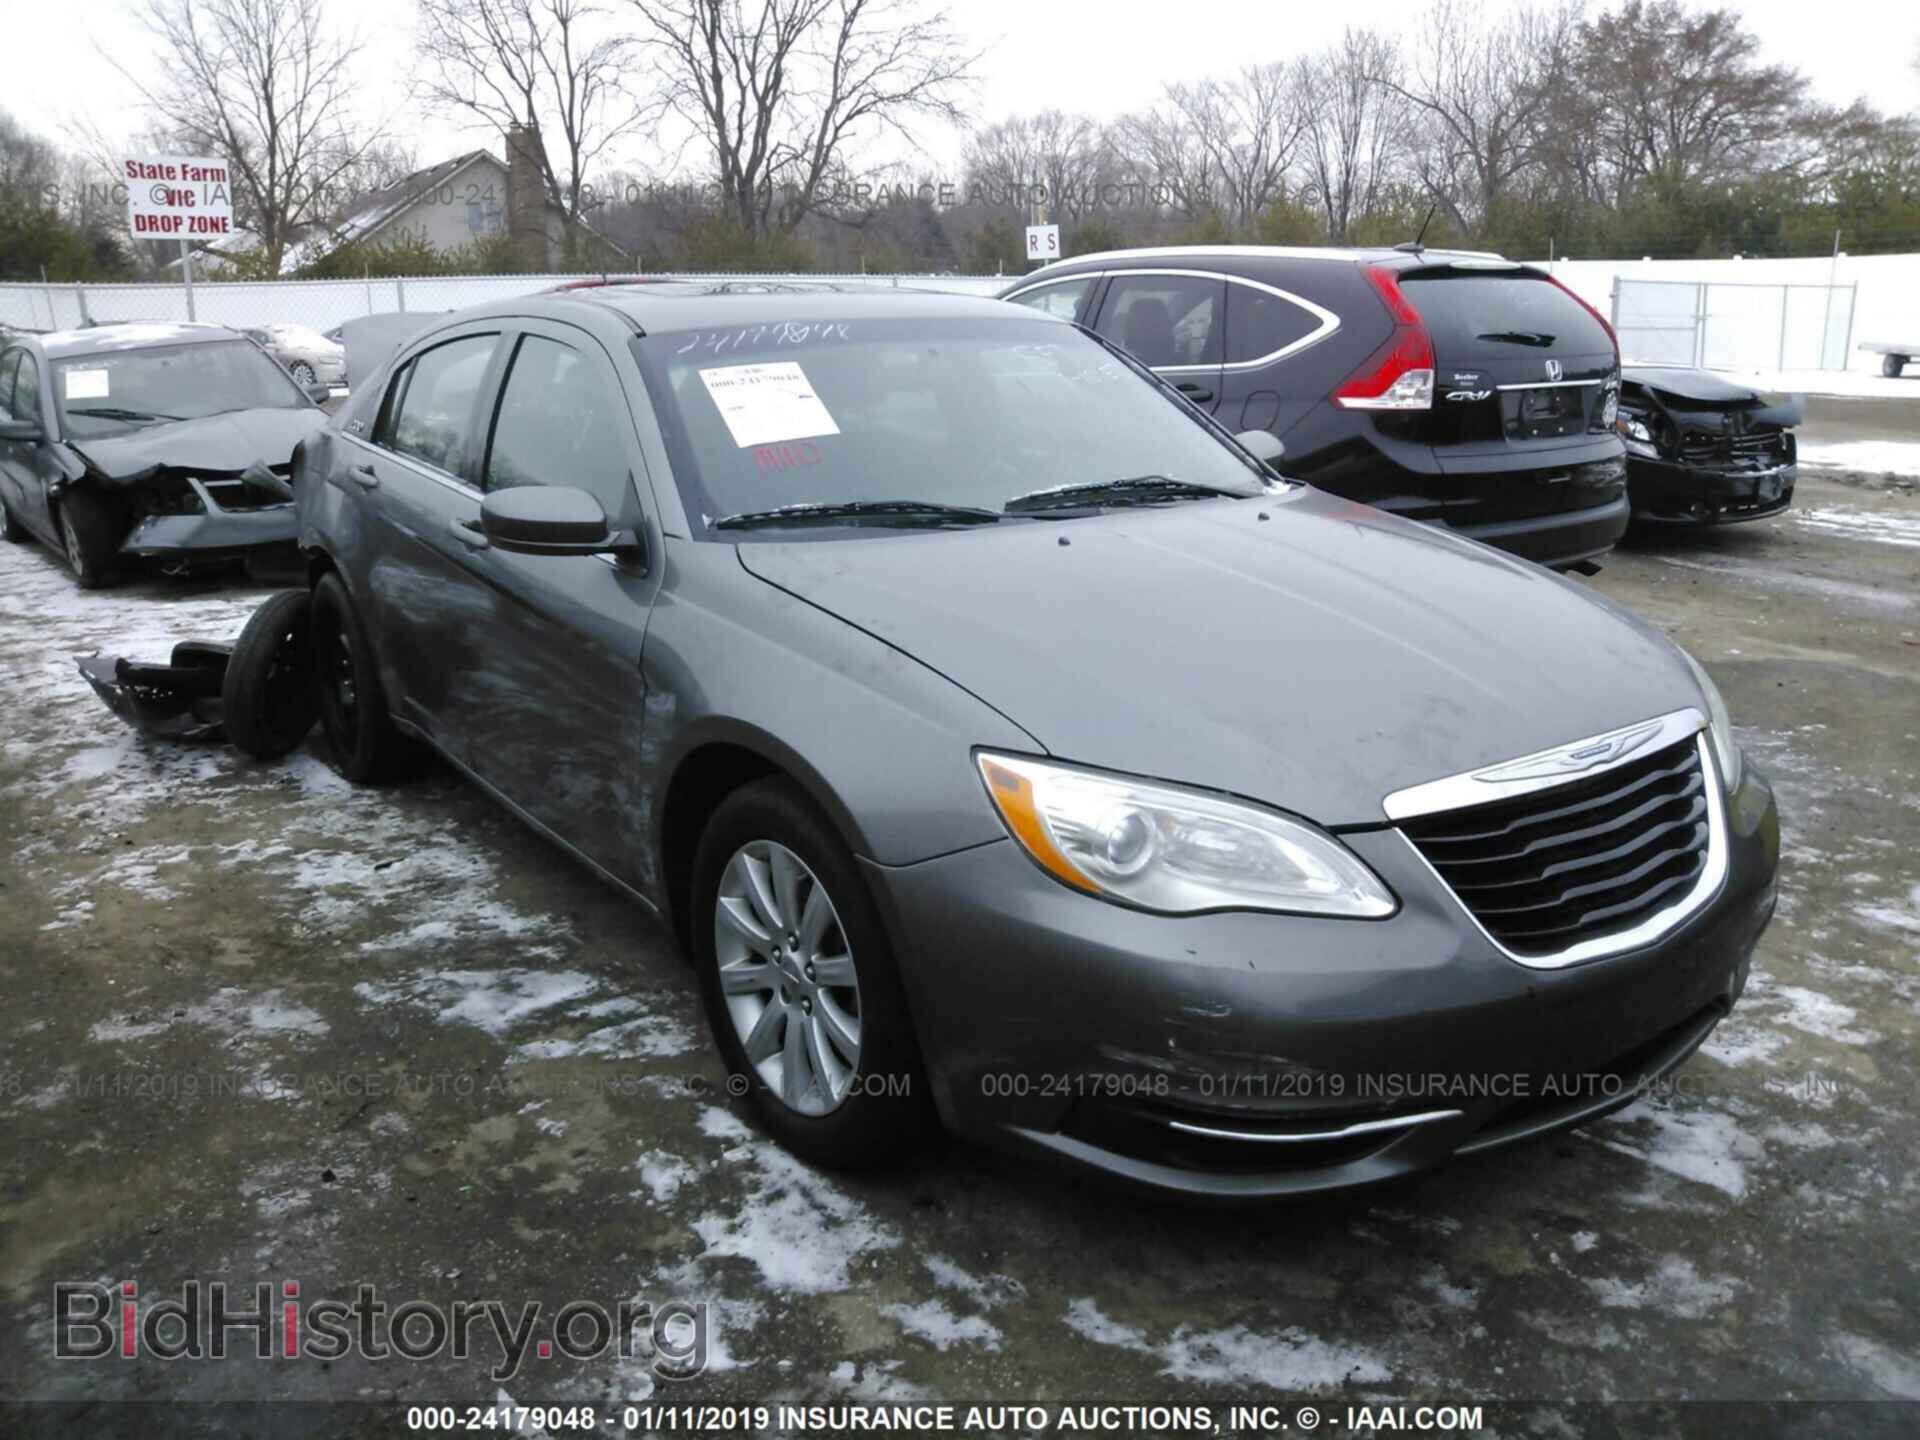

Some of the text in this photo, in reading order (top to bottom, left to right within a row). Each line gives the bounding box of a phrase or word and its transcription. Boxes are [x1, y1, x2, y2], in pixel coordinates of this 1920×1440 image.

[126, 160, 226, 182] State Farm
[134, 214, 230, 233] DROP ZONE
[1030, 233, 1056, 251] R S
